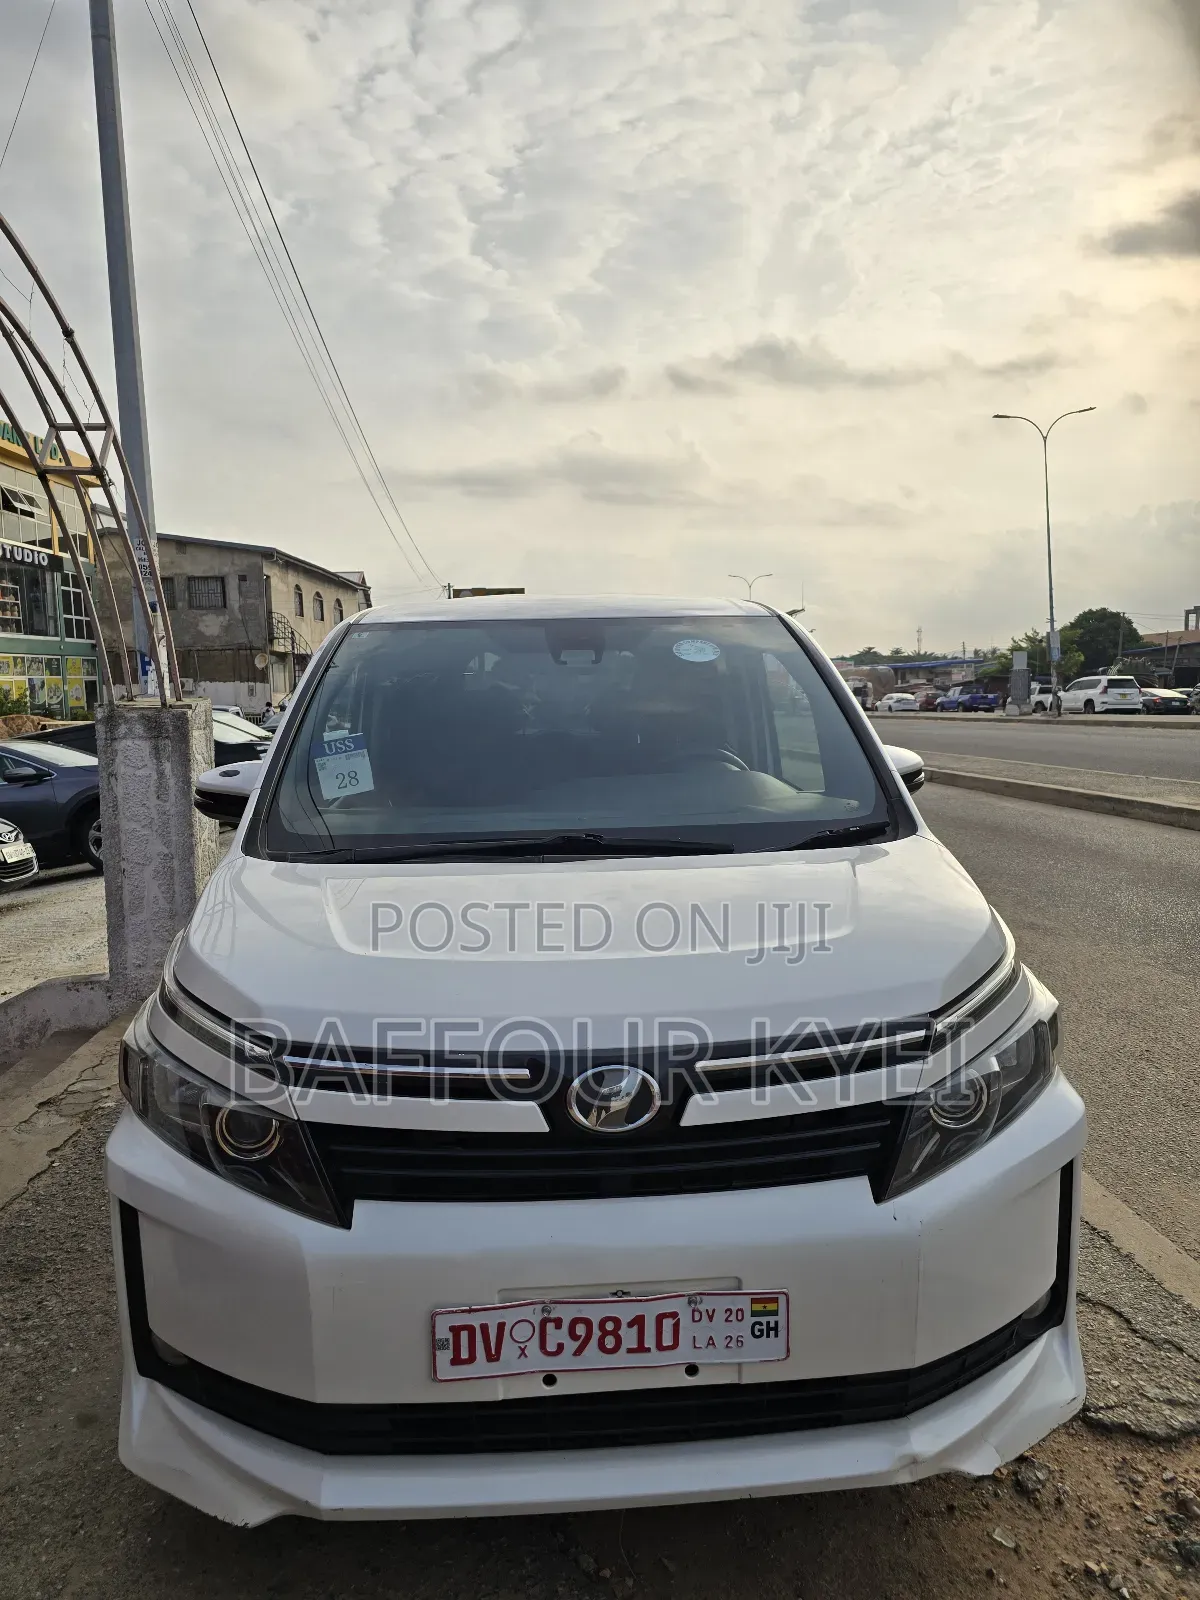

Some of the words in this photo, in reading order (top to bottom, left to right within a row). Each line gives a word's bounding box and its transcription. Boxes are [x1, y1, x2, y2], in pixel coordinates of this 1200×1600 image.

[323, 738, 355, 755] USS
[335, 770, 360, 790] 28
[691, 1308, 716, 1322] DV
[724, 1308, 744, 1322] 20
[448, 1321, 507, 1366] DV
[538, 1310, 681, 1358] C9810
[750, 1320, 779, 1339] GH
[692, 1335, 717, 1349] LA
[724, 1335, 744, 1349] 26
